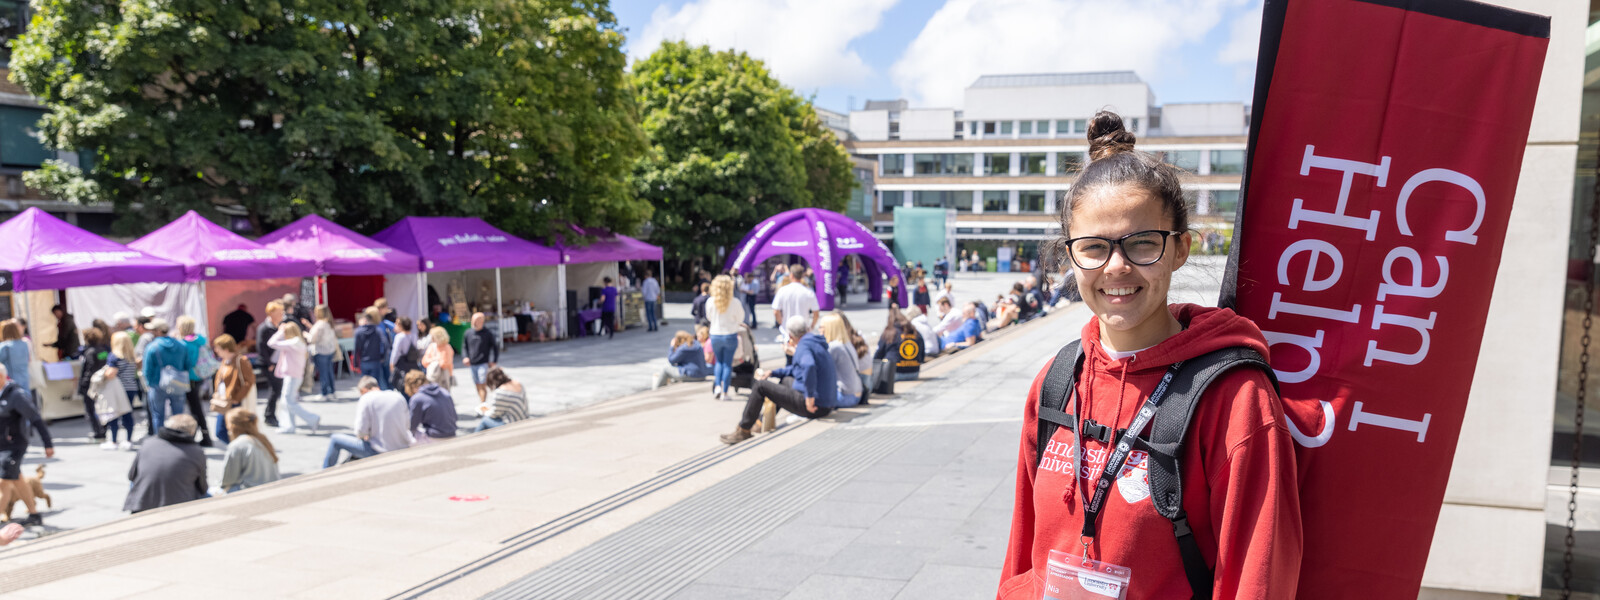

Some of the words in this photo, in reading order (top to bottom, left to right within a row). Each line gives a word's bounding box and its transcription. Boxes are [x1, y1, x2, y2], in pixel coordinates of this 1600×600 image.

[1363, 167, 1487, 368] Can
[1125, 415, 1141, 437] Lancaster
[1347, 401, 1432, 443] I
[1105, 449, 1119, 474] Lancaster
[1109, 452, 1124, 475] University
[1089, 486, 1102, 512] Lancaster
[1047, 584, 1060, 593] Nia
